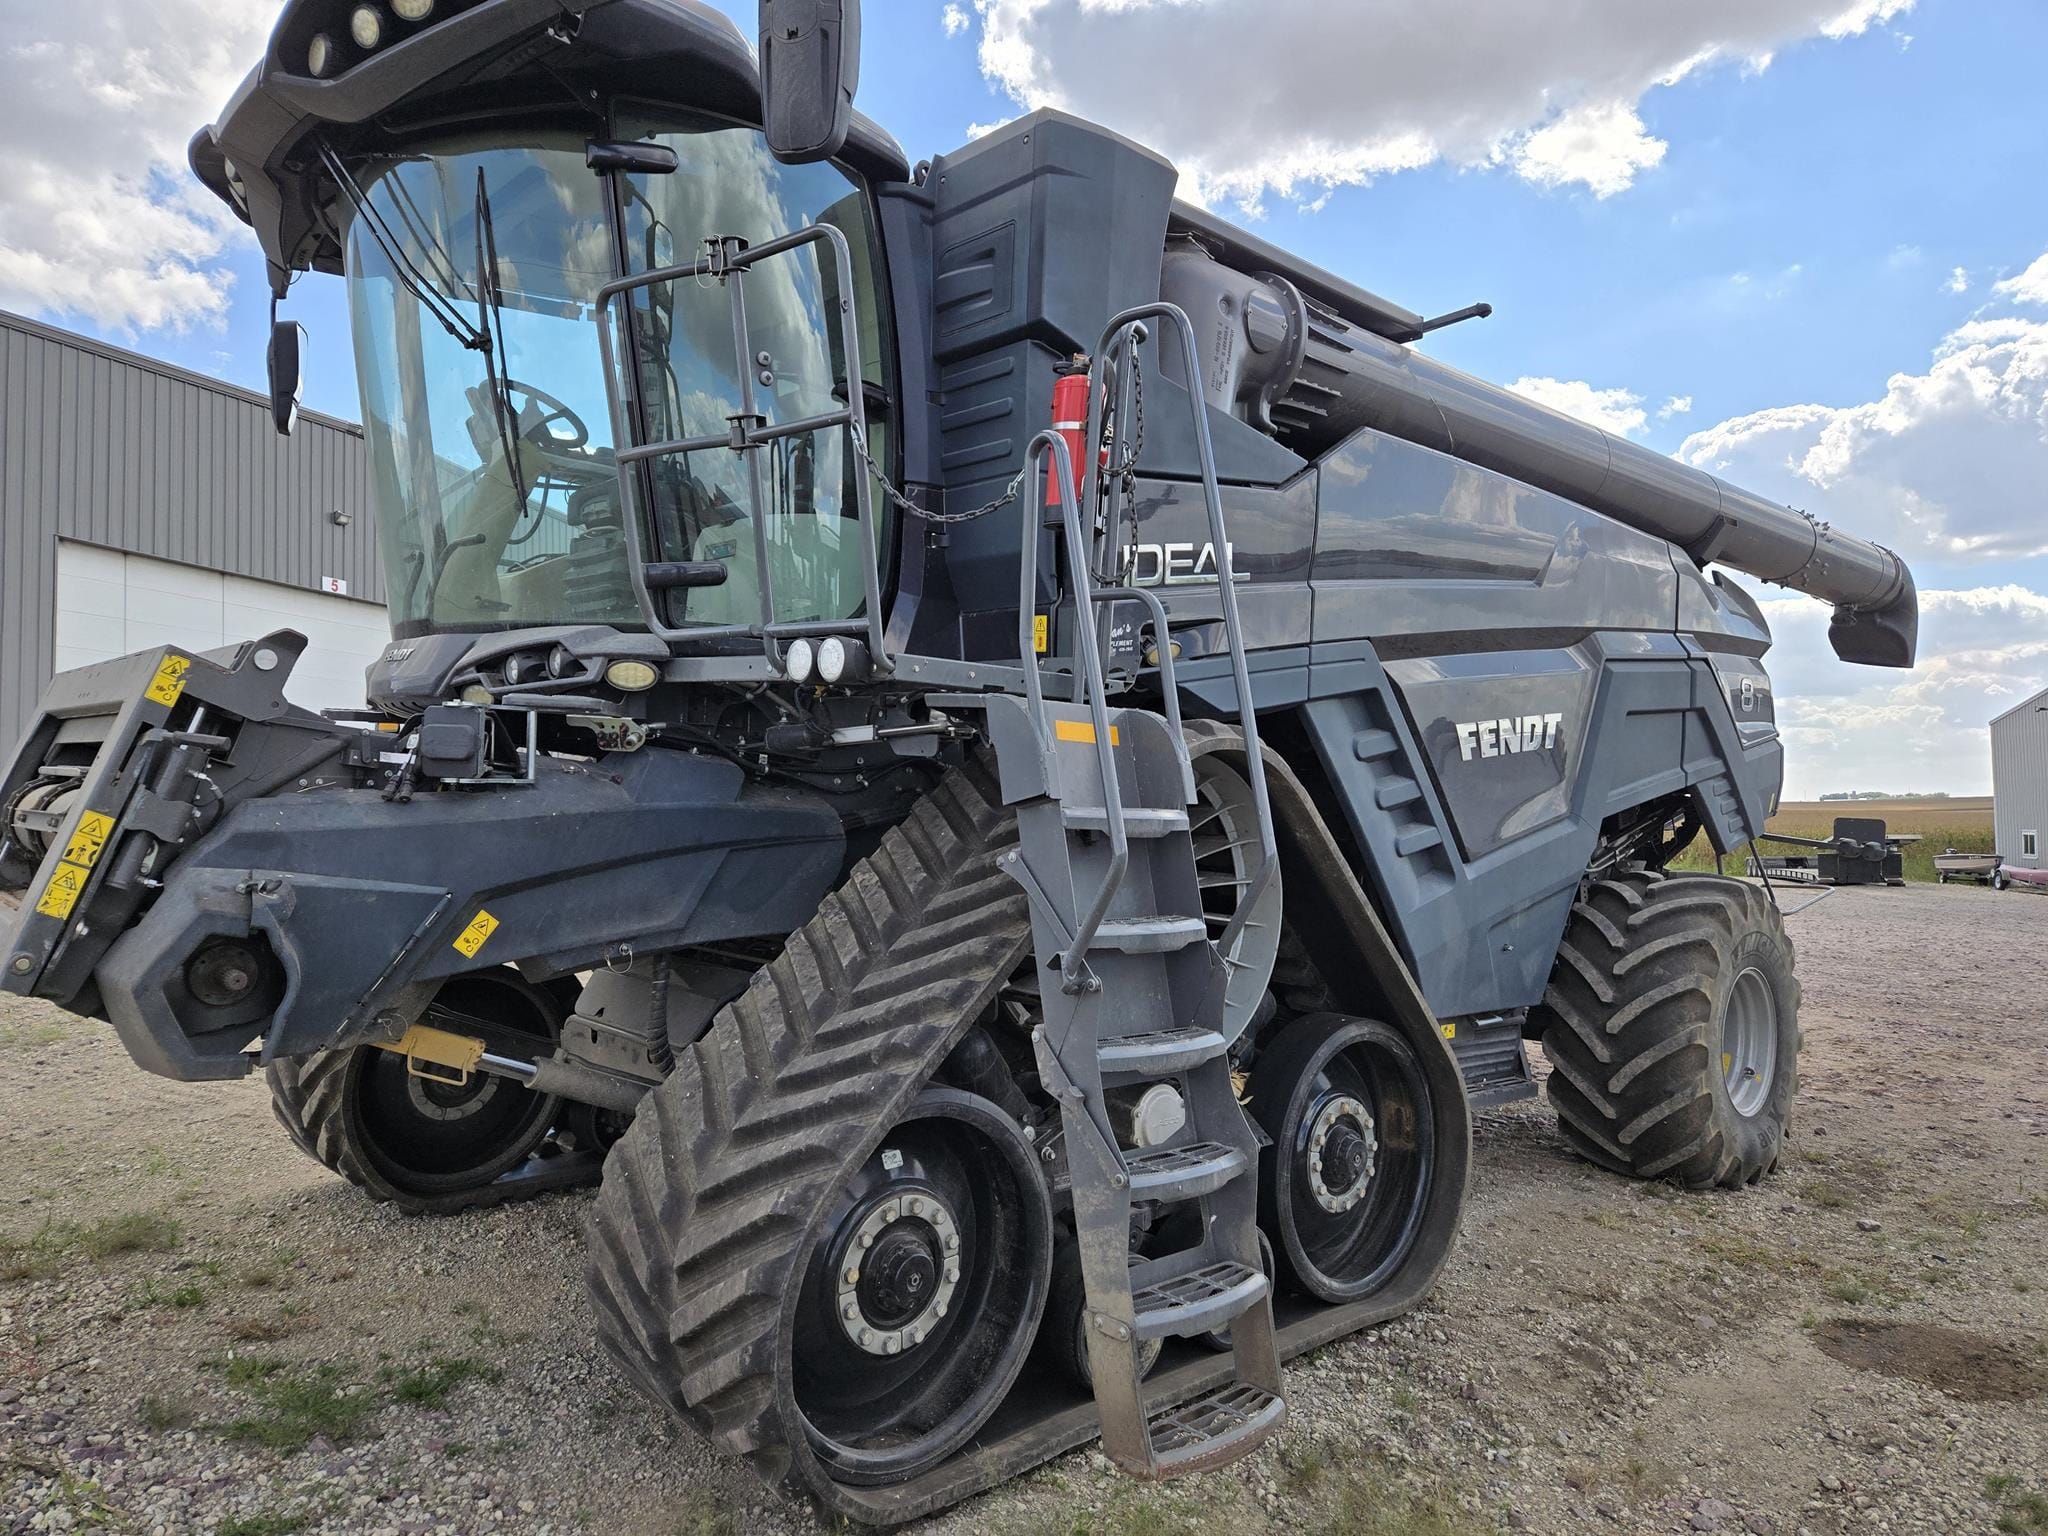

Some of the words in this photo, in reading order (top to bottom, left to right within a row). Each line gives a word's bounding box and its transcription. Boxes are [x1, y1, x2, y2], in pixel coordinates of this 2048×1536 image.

[331, 579, 339, 592] 5
[1122, 542, 1251, 587] IDEAL
[1455, 712, 1563, 762] FENDT
